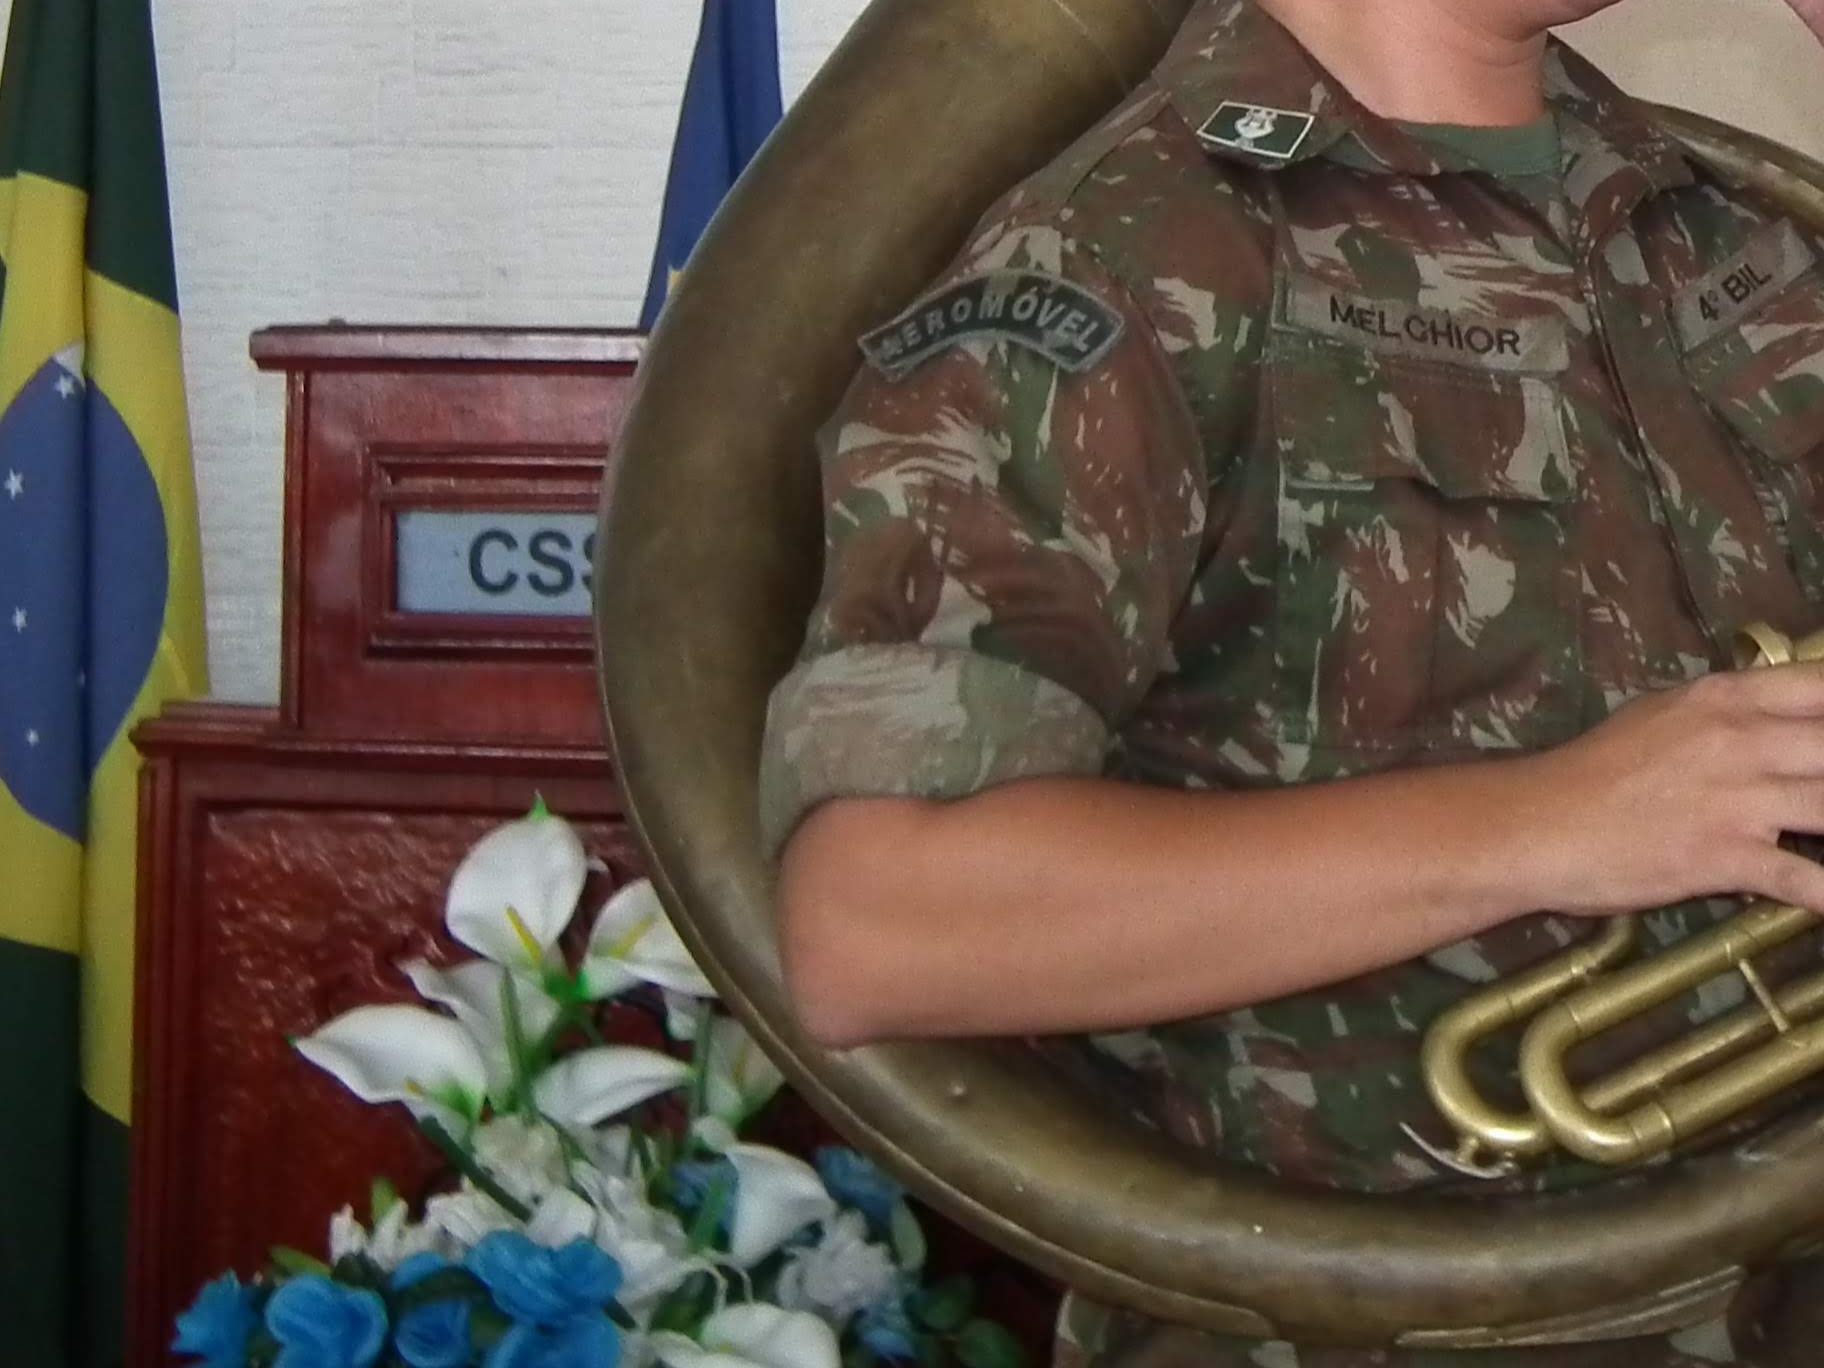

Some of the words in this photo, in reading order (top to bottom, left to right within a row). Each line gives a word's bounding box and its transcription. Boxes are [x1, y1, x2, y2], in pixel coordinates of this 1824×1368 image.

[1726, 266, 1773, 307] BIL
[1330, 293, 1522, 355] MELCHIOR
[469, 529, 596, 596] CS
